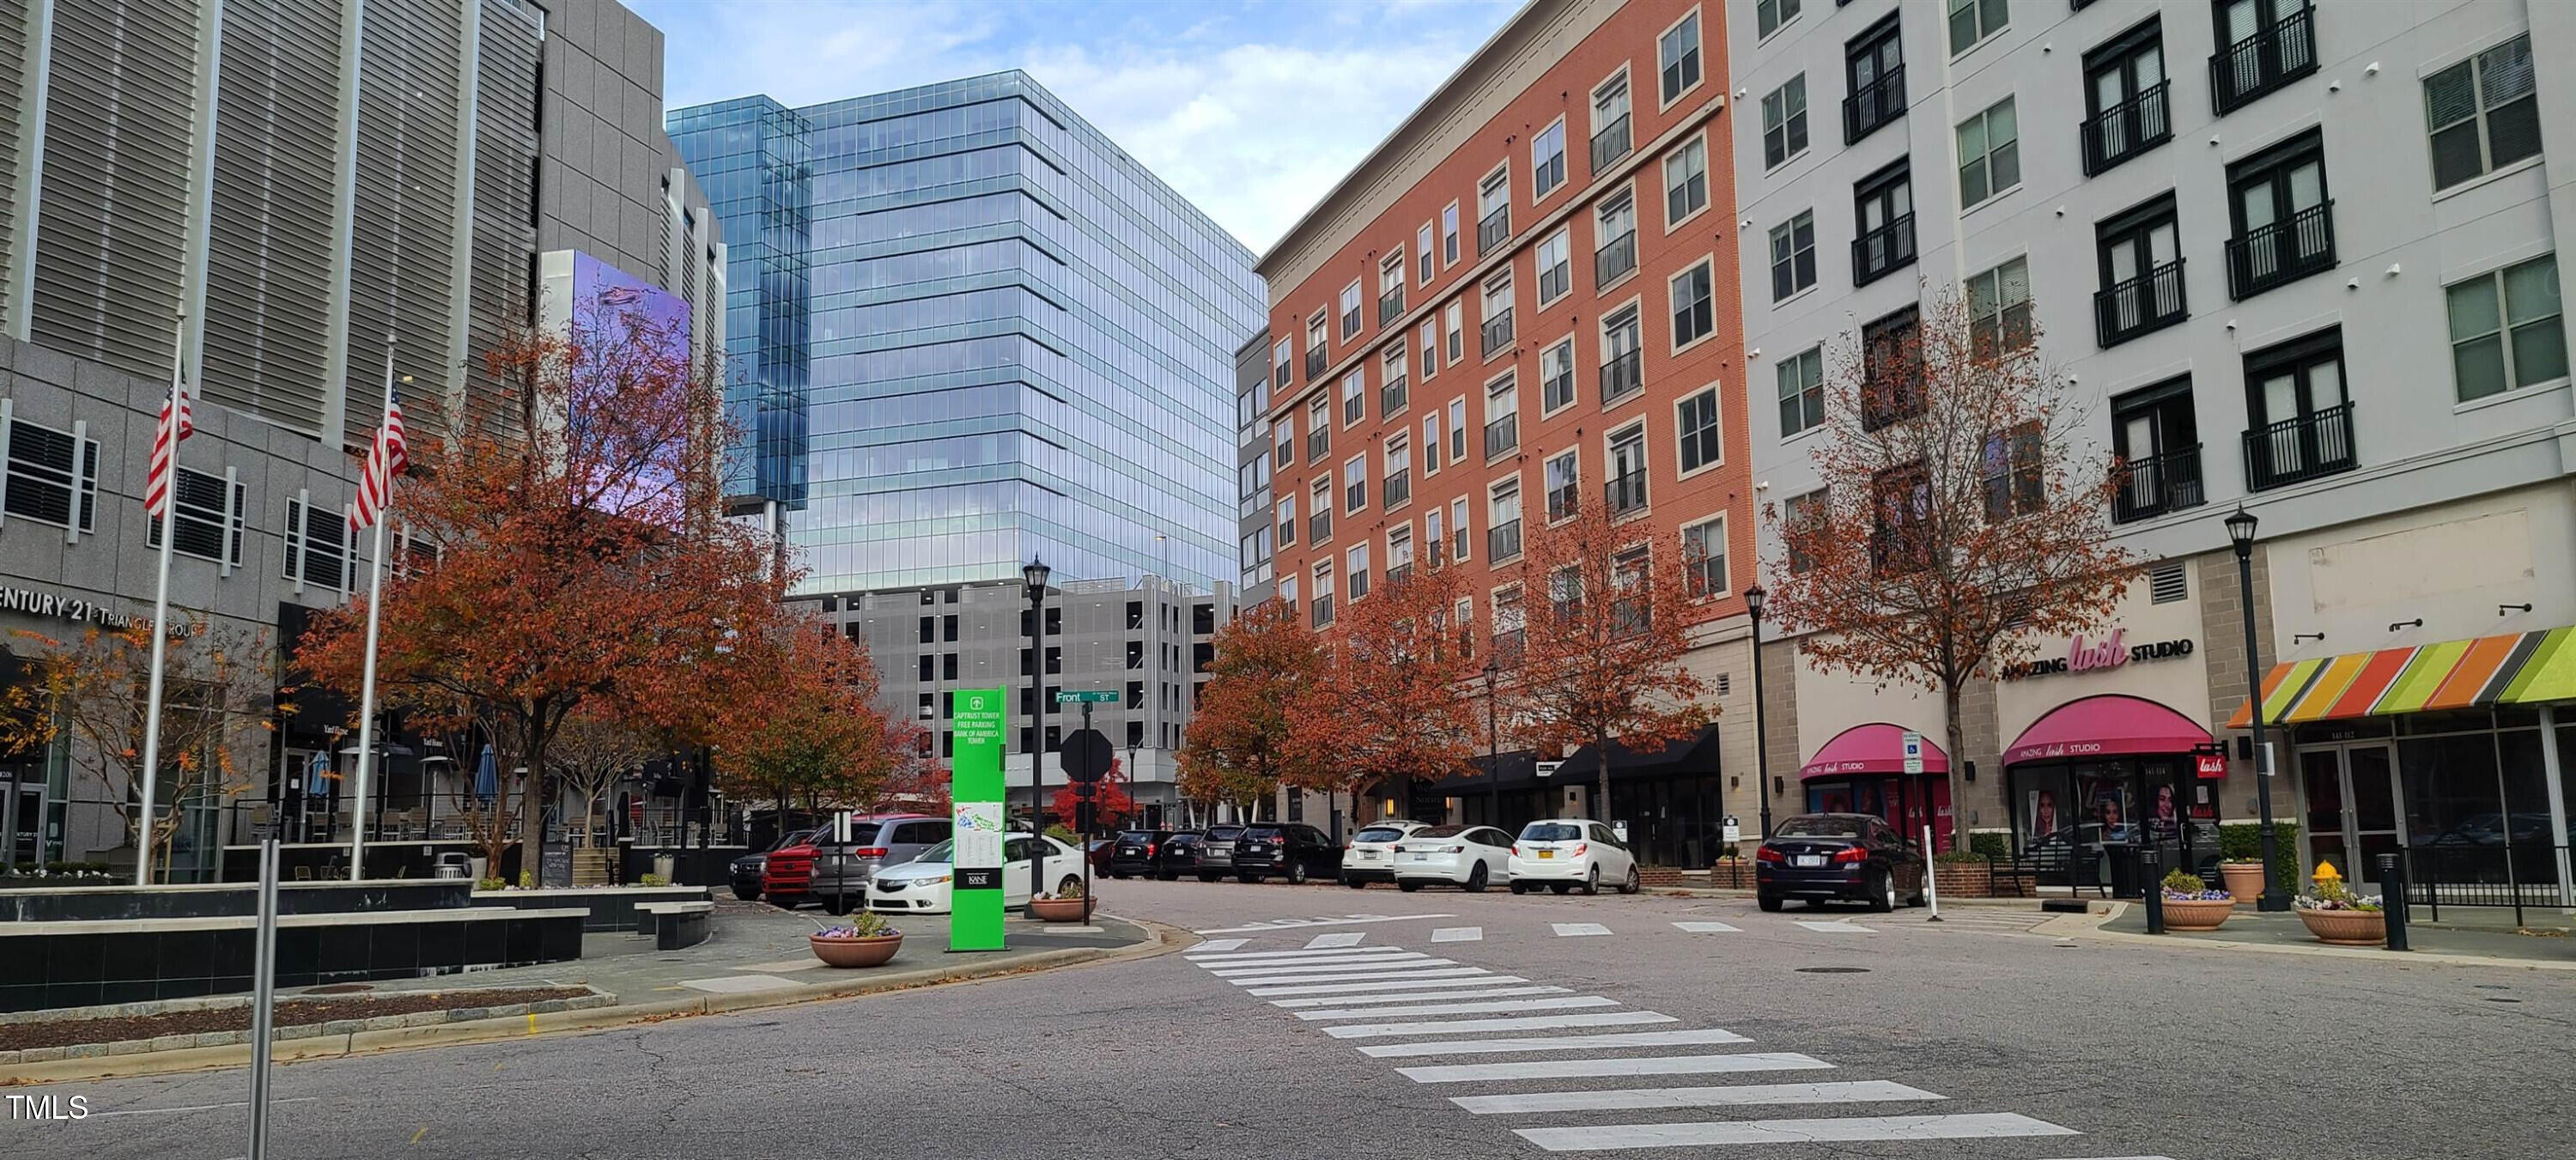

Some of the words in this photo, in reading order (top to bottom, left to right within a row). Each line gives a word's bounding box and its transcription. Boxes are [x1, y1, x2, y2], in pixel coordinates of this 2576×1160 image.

[71, 599, 92, 622] 21
[167, 619, 200, 638] ROUP
[2131, 638, 2194, 661] STUDIO
[1056, 692, 1080, 702] Front
[2020, 748, 2042, 757] AMAZING
[2070, 743, 2100, 753] STUDIO
[1841, 761, 1864, 770] STUDIO
[2200, 758, 2224, 772] lash
[969, 875, 987, 885] KANE
